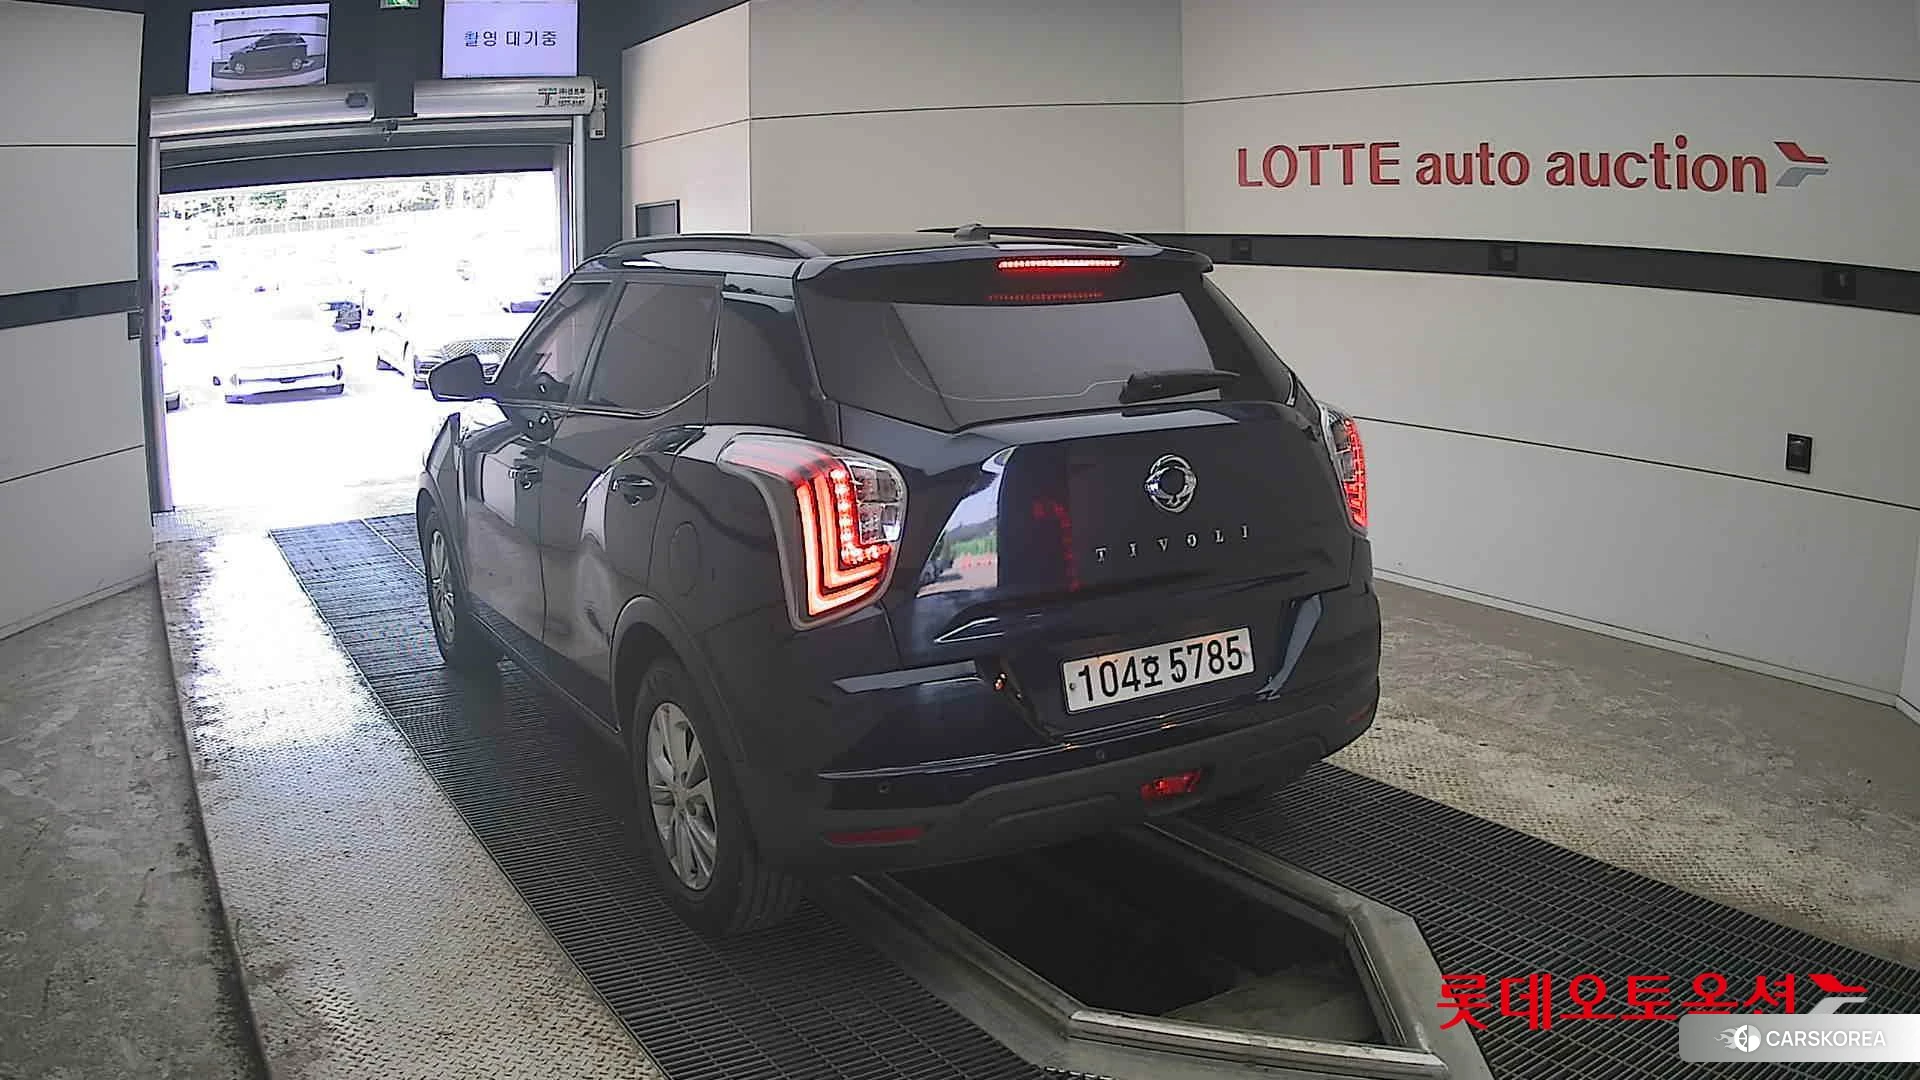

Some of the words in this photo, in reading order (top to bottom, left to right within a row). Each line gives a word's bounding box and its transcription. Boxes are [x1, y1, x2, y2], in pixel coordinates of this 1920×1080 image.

[505, 31, 558, 48] 대기중
[1238, 142, 1400, 188] LOTTE
[1415, 142, 1531, 187] auto
[1545, 135, 1768, 194] auction
[1096, 525, 1249, 562] TIVOLI
[1078, 655, 1163, 702] 104호
[1169, 635, 1243, 683] 5785
